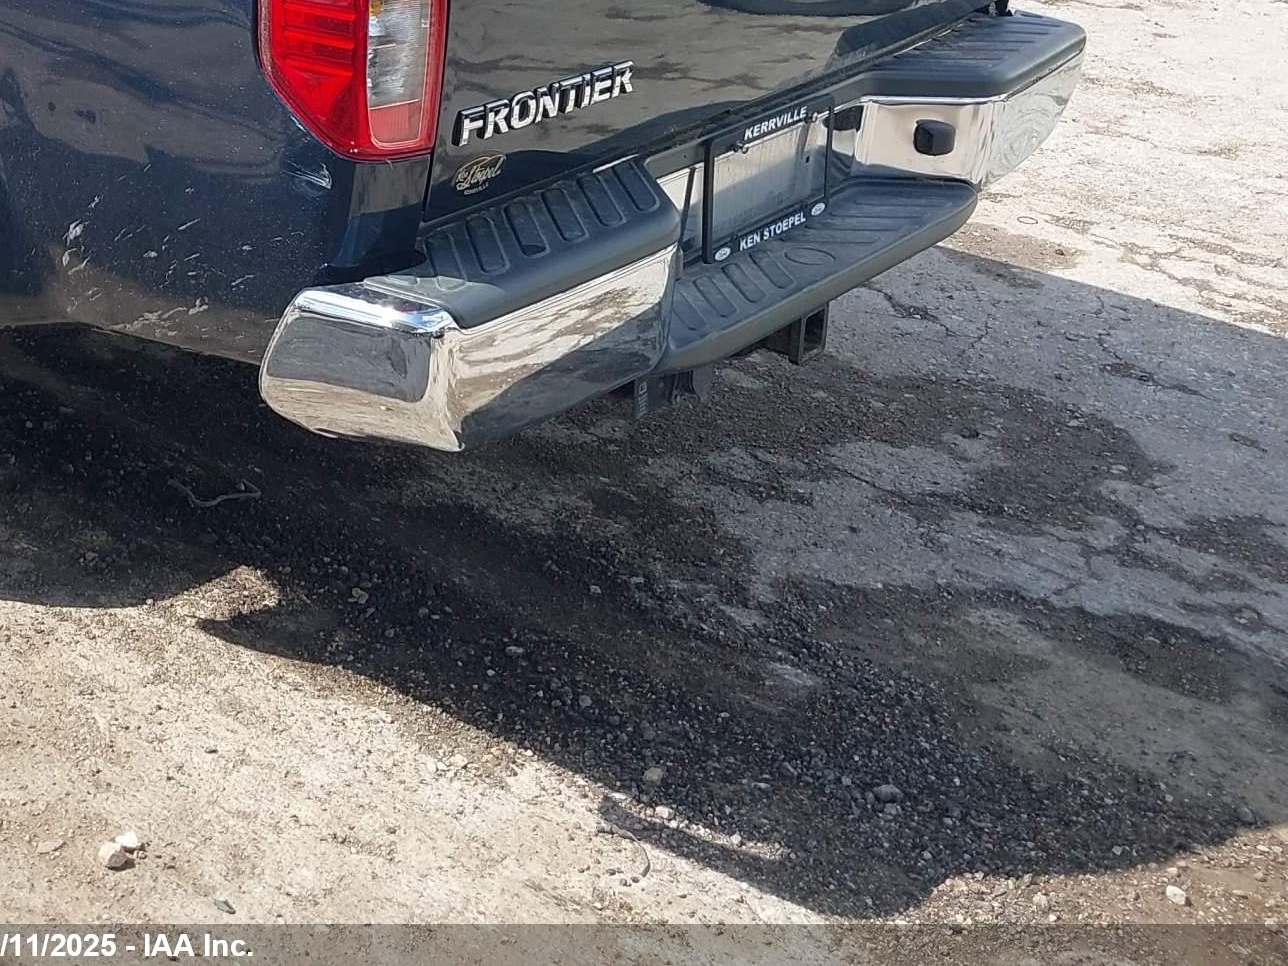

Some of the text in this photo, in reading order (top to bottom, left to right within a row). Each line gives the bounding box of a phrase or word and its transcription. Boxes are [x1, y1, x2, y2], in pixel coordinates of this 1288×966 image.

[452, 60, 634, 146] FRONTIER
[744, 106, 807, 141] KERRVILLE
[739, 211, 806, 251] KEN STOEPEL
